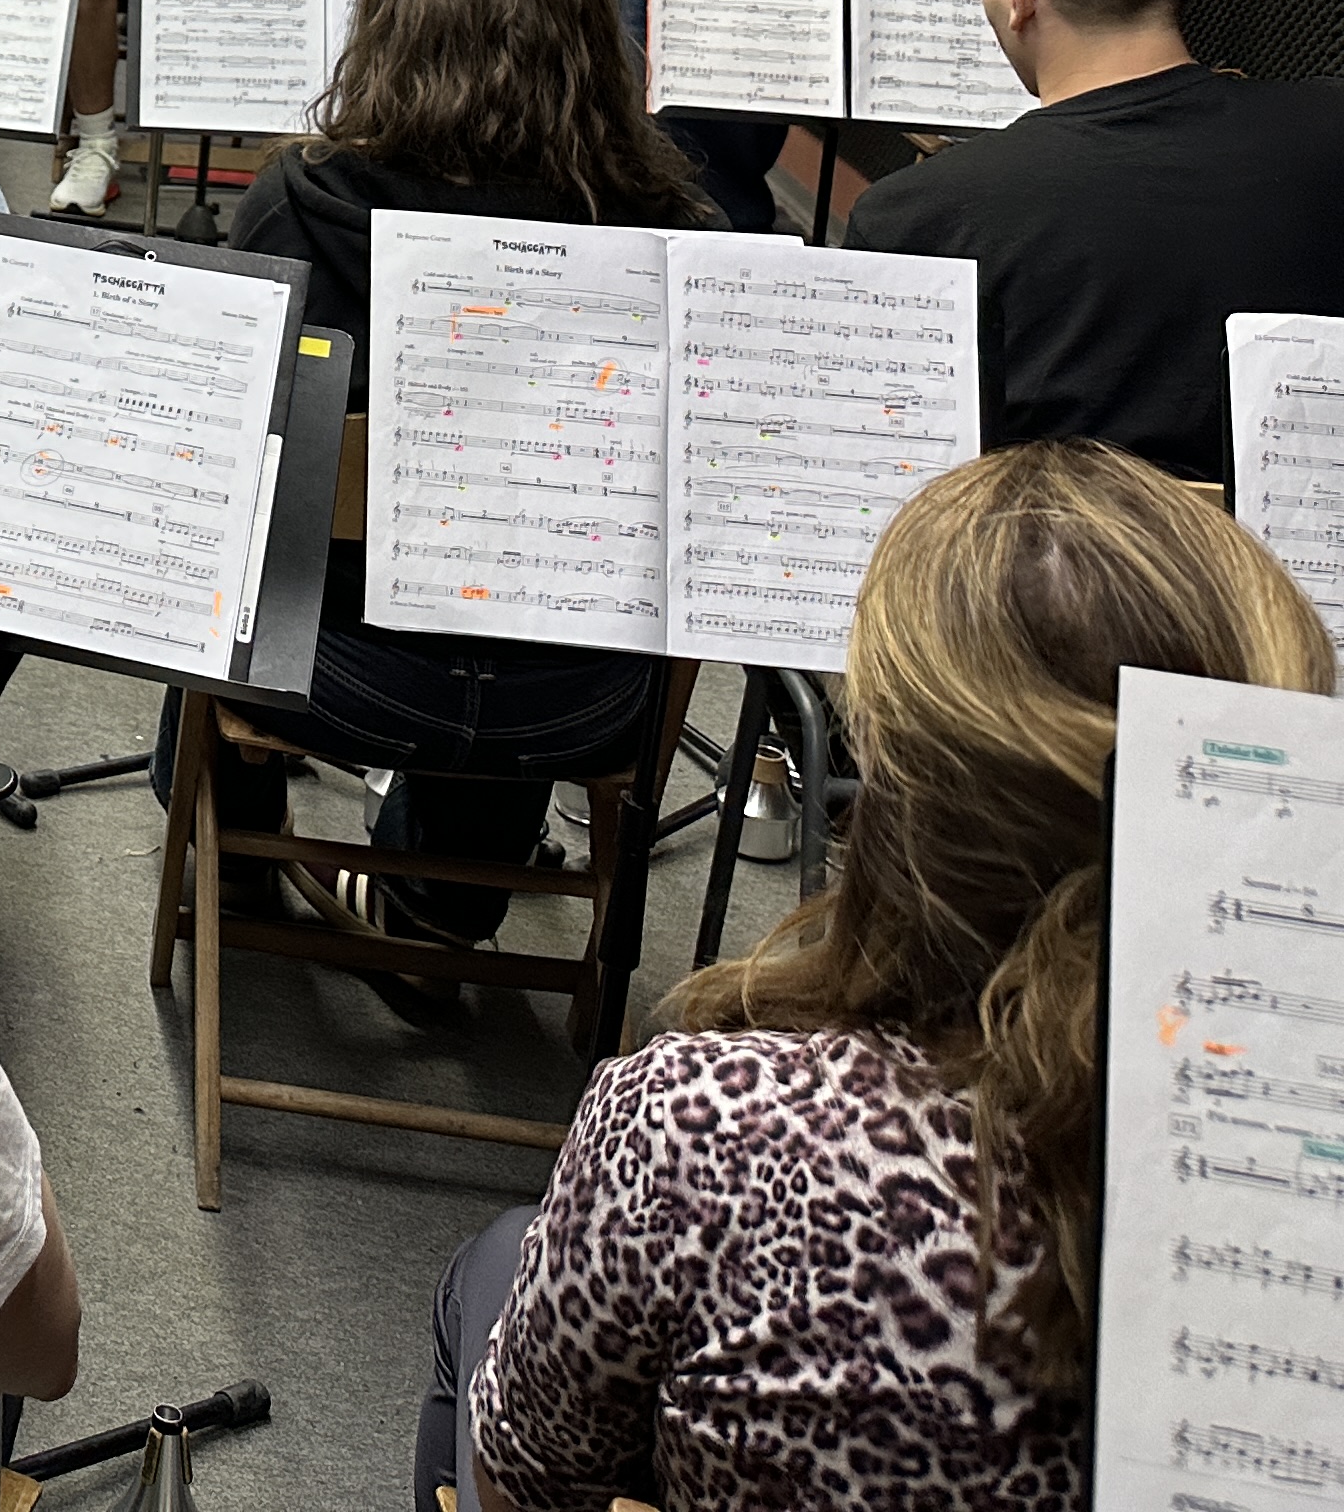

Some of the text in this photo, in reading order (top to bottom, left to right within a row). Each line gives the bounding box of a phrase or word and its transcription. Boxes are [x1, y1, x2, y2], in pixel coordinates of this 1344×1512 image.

[504, 265, 523, 274] Birth
[541, 268, 562, 279] Story
[101, 291, 121, 302] Birth
[138, 297, 159, 309] Story
